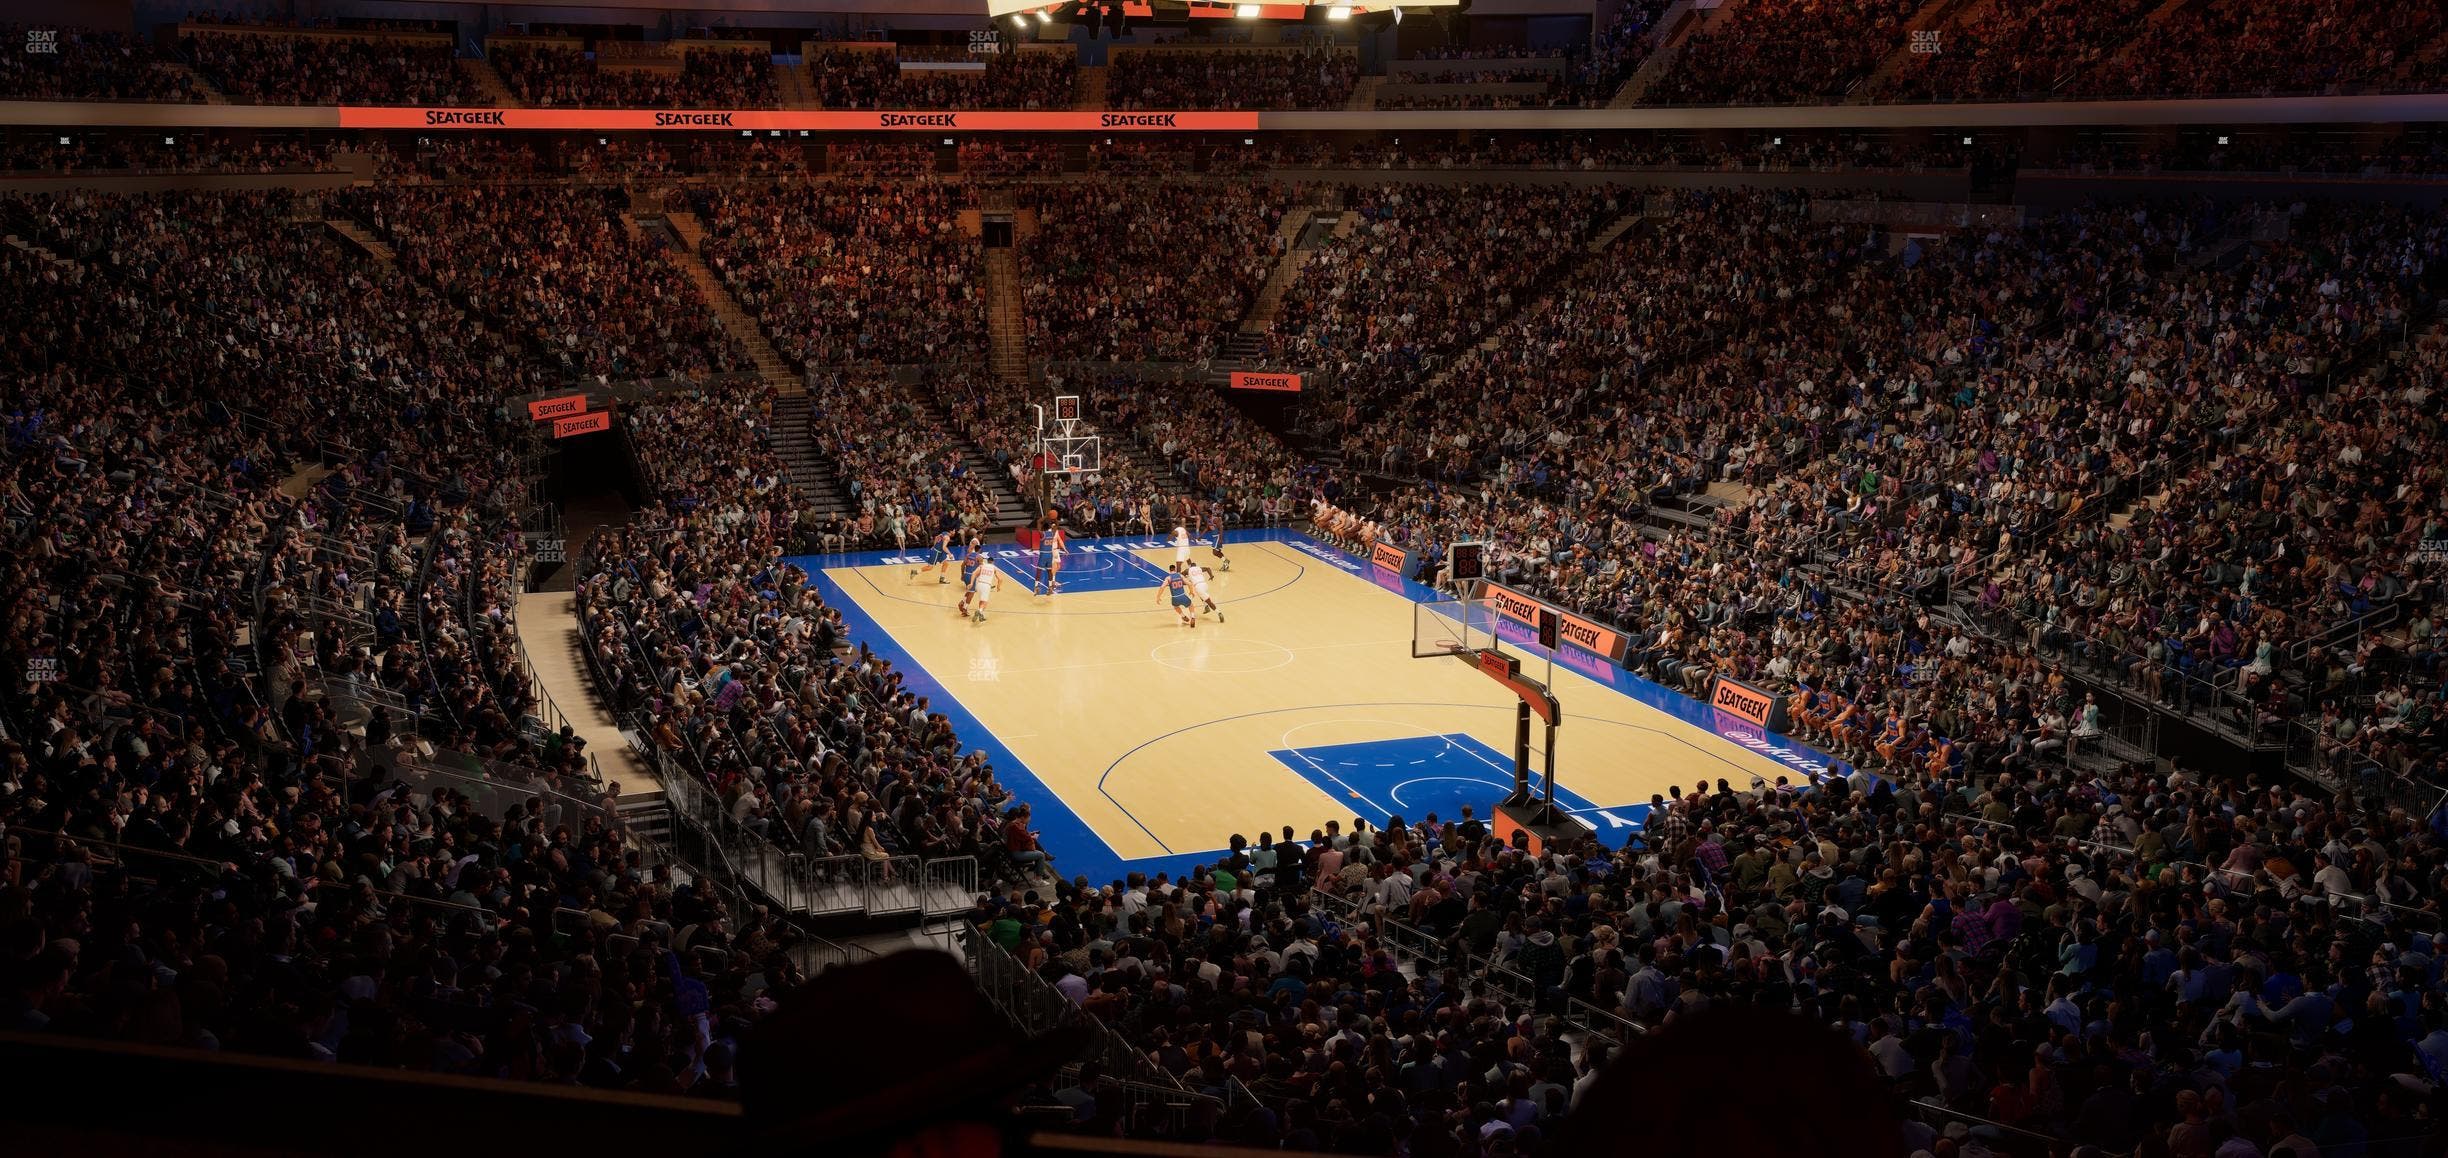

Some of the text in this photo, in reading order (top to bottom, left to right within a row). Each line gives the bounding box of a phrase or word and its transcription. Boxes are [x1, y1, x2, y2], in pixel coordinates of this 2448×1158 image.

[426, 110, 505, 126] SEATGEEK
[655, 111, 733, 127] SEATGEEK
[880, 112, 957, 127] SEATGEEK
[1101, 112, 1177, 127] SEATGEEK
[1243, 376, 1289, 388] SEATGEEK
[538, 400, 577, 416] SEATGEEK
[563, 417, 600, 434] SEATGEEK
[1374, 547, 1405, 570] SEATGEEK
[1495, 591, 1536, 623] SEATGEEK
[1484, 654, 1506, 673] SEATGEEK
[1717, 685, 1769, 721] SEATGEEK
